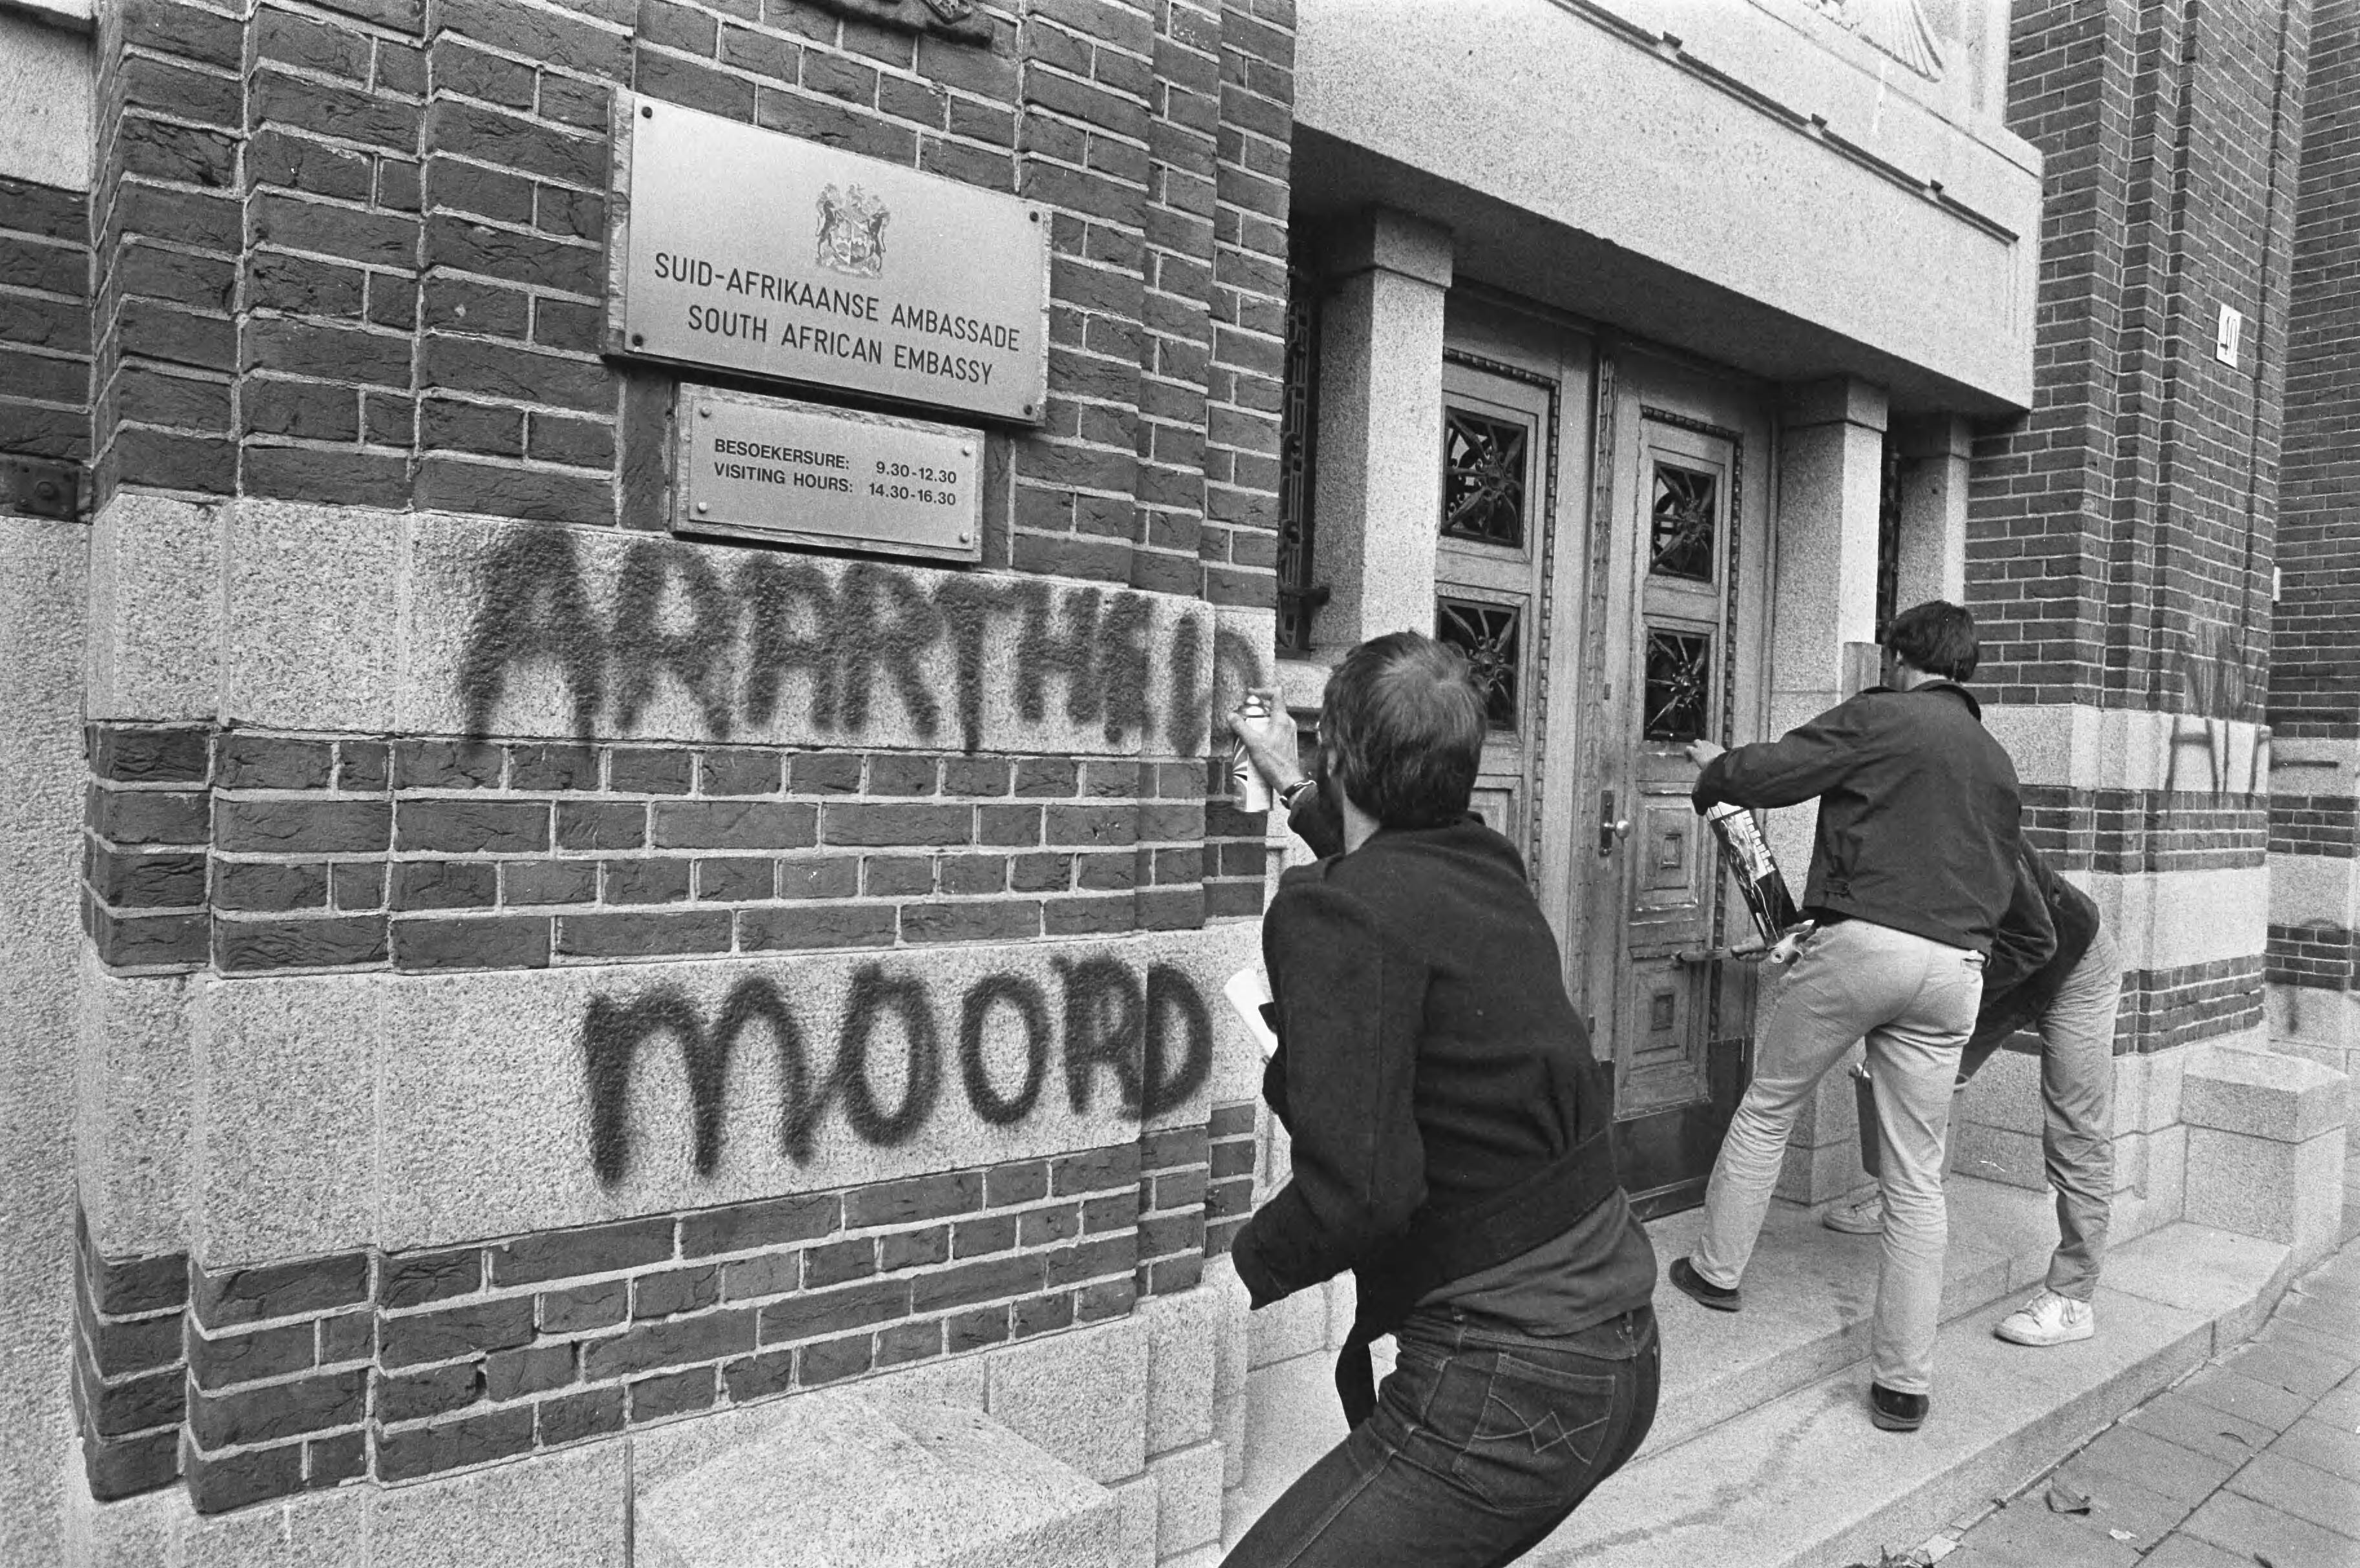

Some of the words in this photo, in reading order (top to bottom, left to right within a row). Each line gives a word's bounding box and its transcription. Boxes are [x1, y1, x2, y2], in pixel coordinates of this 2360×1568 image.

[654, 252, 880, 322] SUID-AFRIKAANSE
[890, 303, 1020, 352] AMBASSADE
[688, 305, 768, 343] SOUTH
[781, 324, 883, 365] AFRICAN
[894, 346, 993, 385] EMBASSY
[2219, 315, 2238, 359] 40
[714, 438, 850, 470] BESOEKERSURE:
[876, 461, 957, 485] 9.30-12.30
[714, 462, 786, 485] VISITING
[794, 472, 853, 493] HOURS:
[869, 483, 956, 506] 14.30-16.30
[583, 952, 1212, 1192] MOORD
